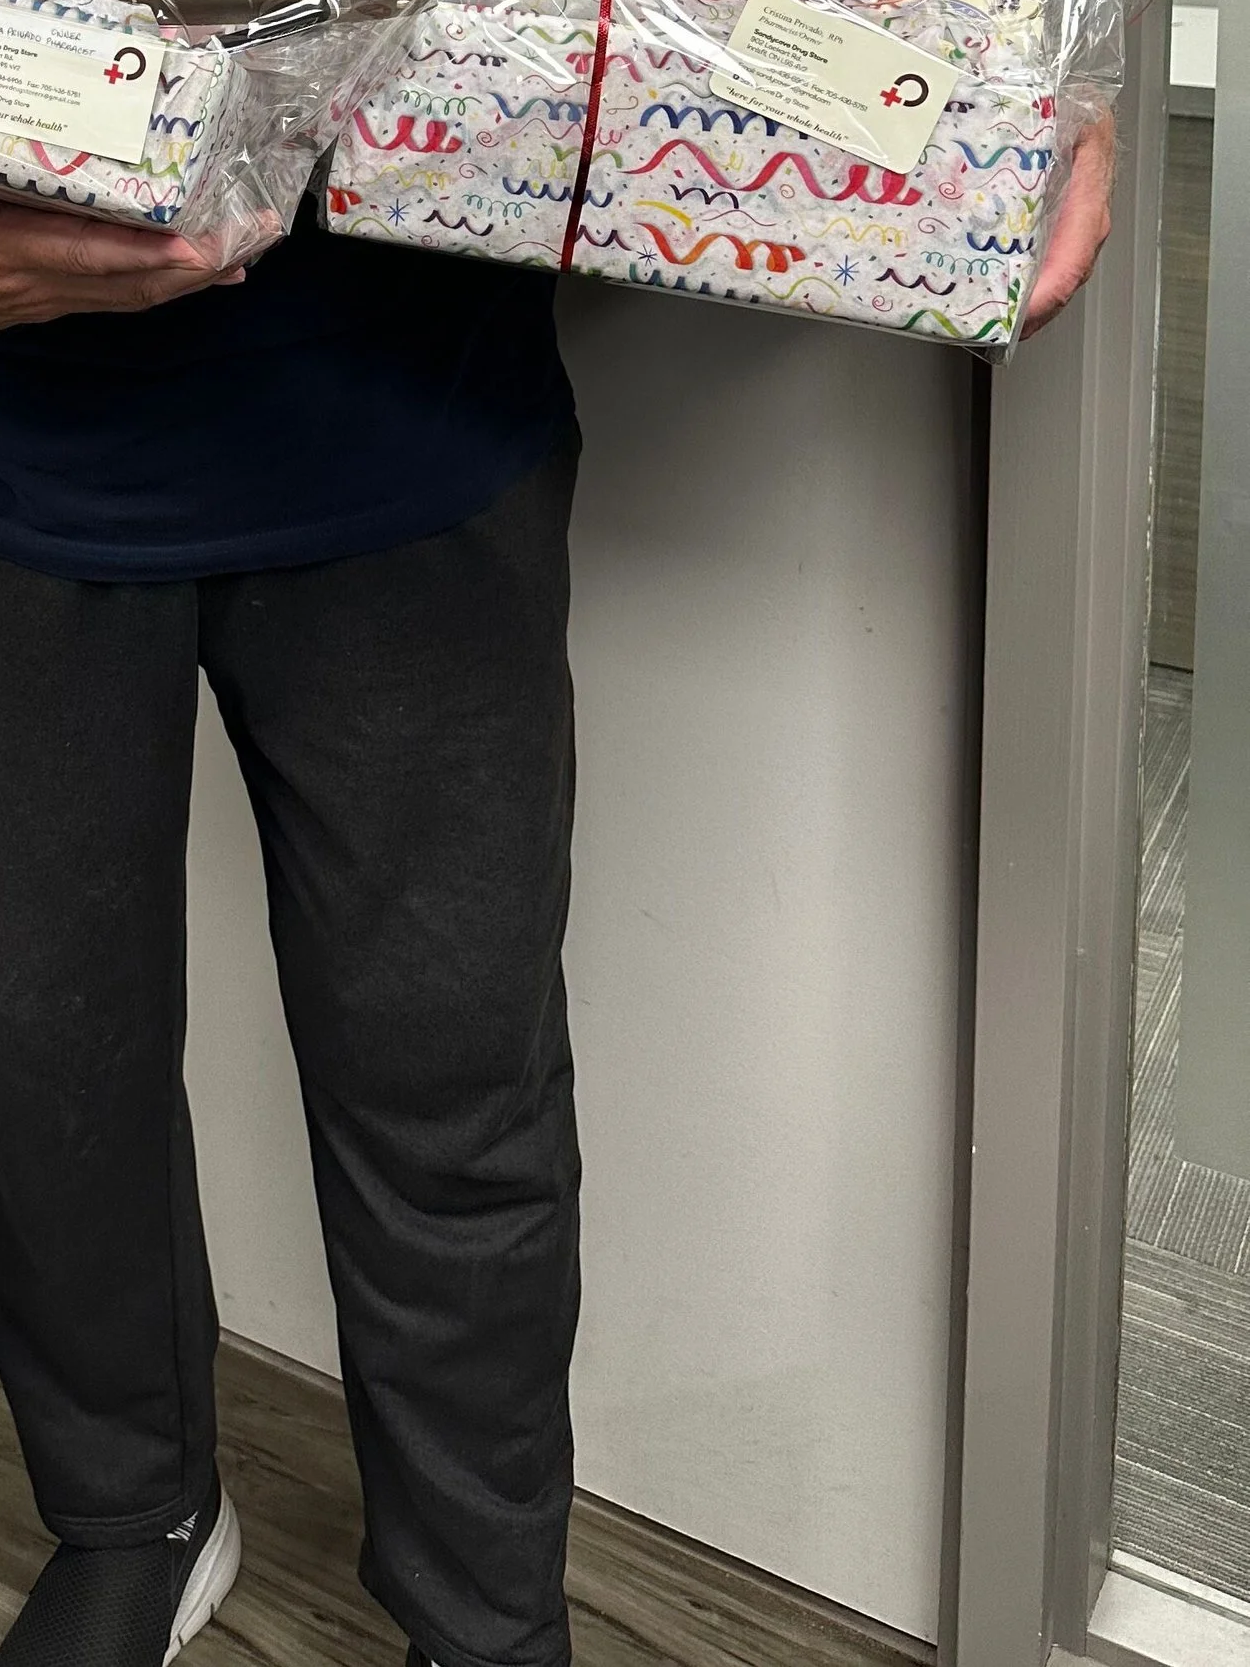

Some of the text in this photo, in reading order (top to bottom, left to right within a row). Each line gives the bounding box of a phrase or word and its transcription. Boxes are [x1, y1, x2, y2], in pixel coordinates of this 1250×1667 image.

[763, 6, 792, 23] Cristina
[827, 33, 844, 44] RPh
[3, 45, 19, 55] Drug
[20, 49, 38, 58] Store
[754, 28, 828, 64] Sandycove Drug Store
[14, 99, 30, 108] Store
[792, 99, 810, 110] Store
[748, 96, 763, 107] for
[763, 104, 786, 116] your
[787, 111, 812, 128] whole
[10, 113, 35, 126] whole
